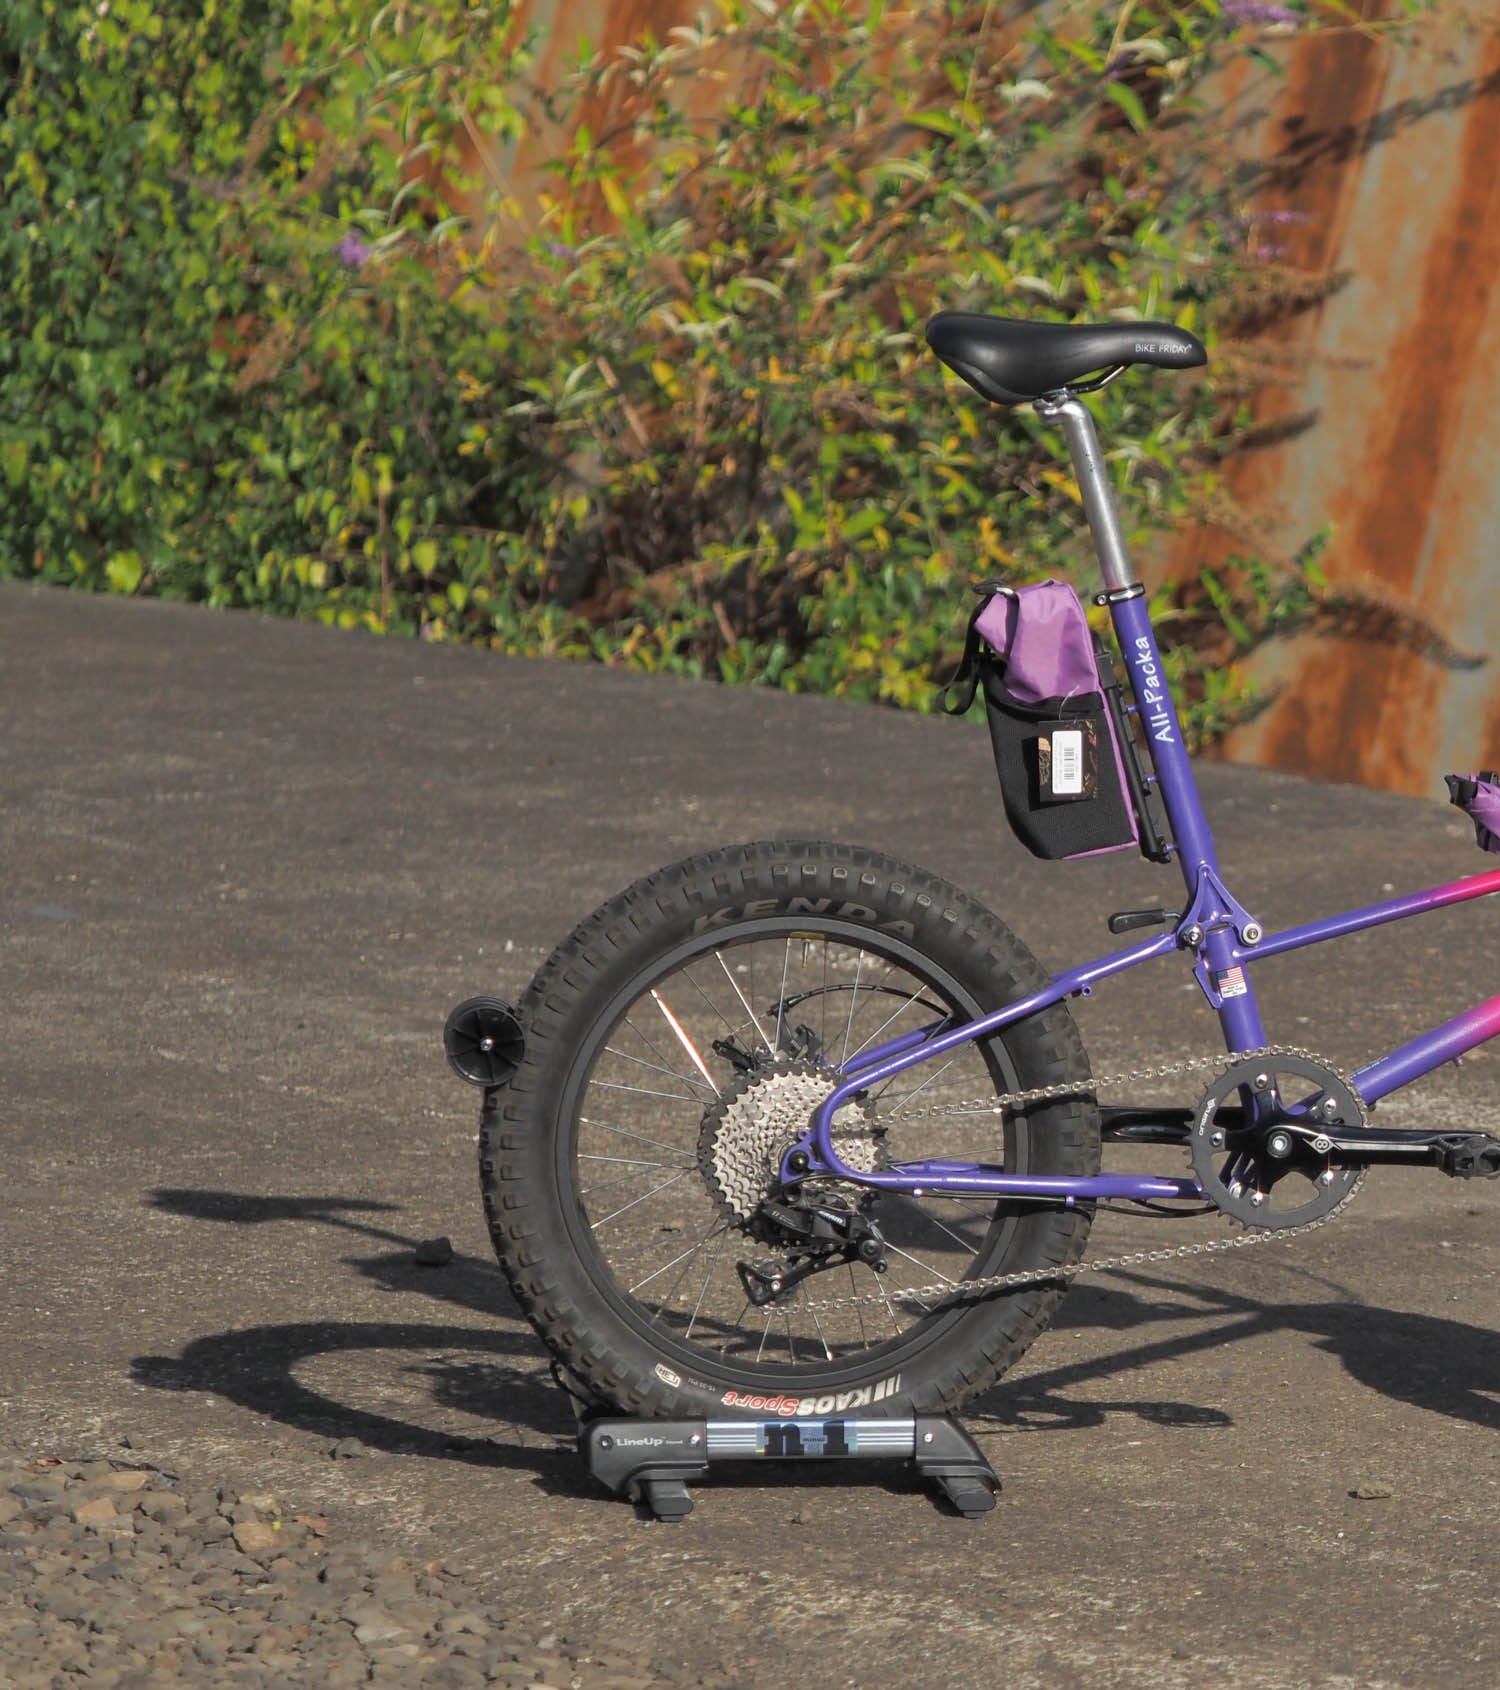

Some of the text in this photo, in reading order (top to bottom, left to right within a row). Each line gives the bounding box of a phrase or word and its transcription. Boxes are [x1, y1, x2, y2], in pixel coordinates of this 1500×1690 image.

[1135, 344, 1156, 353] BIKE
[1135, 636, 1175, 743] All-Packa
[691, 897, 916, 940] KENDA
